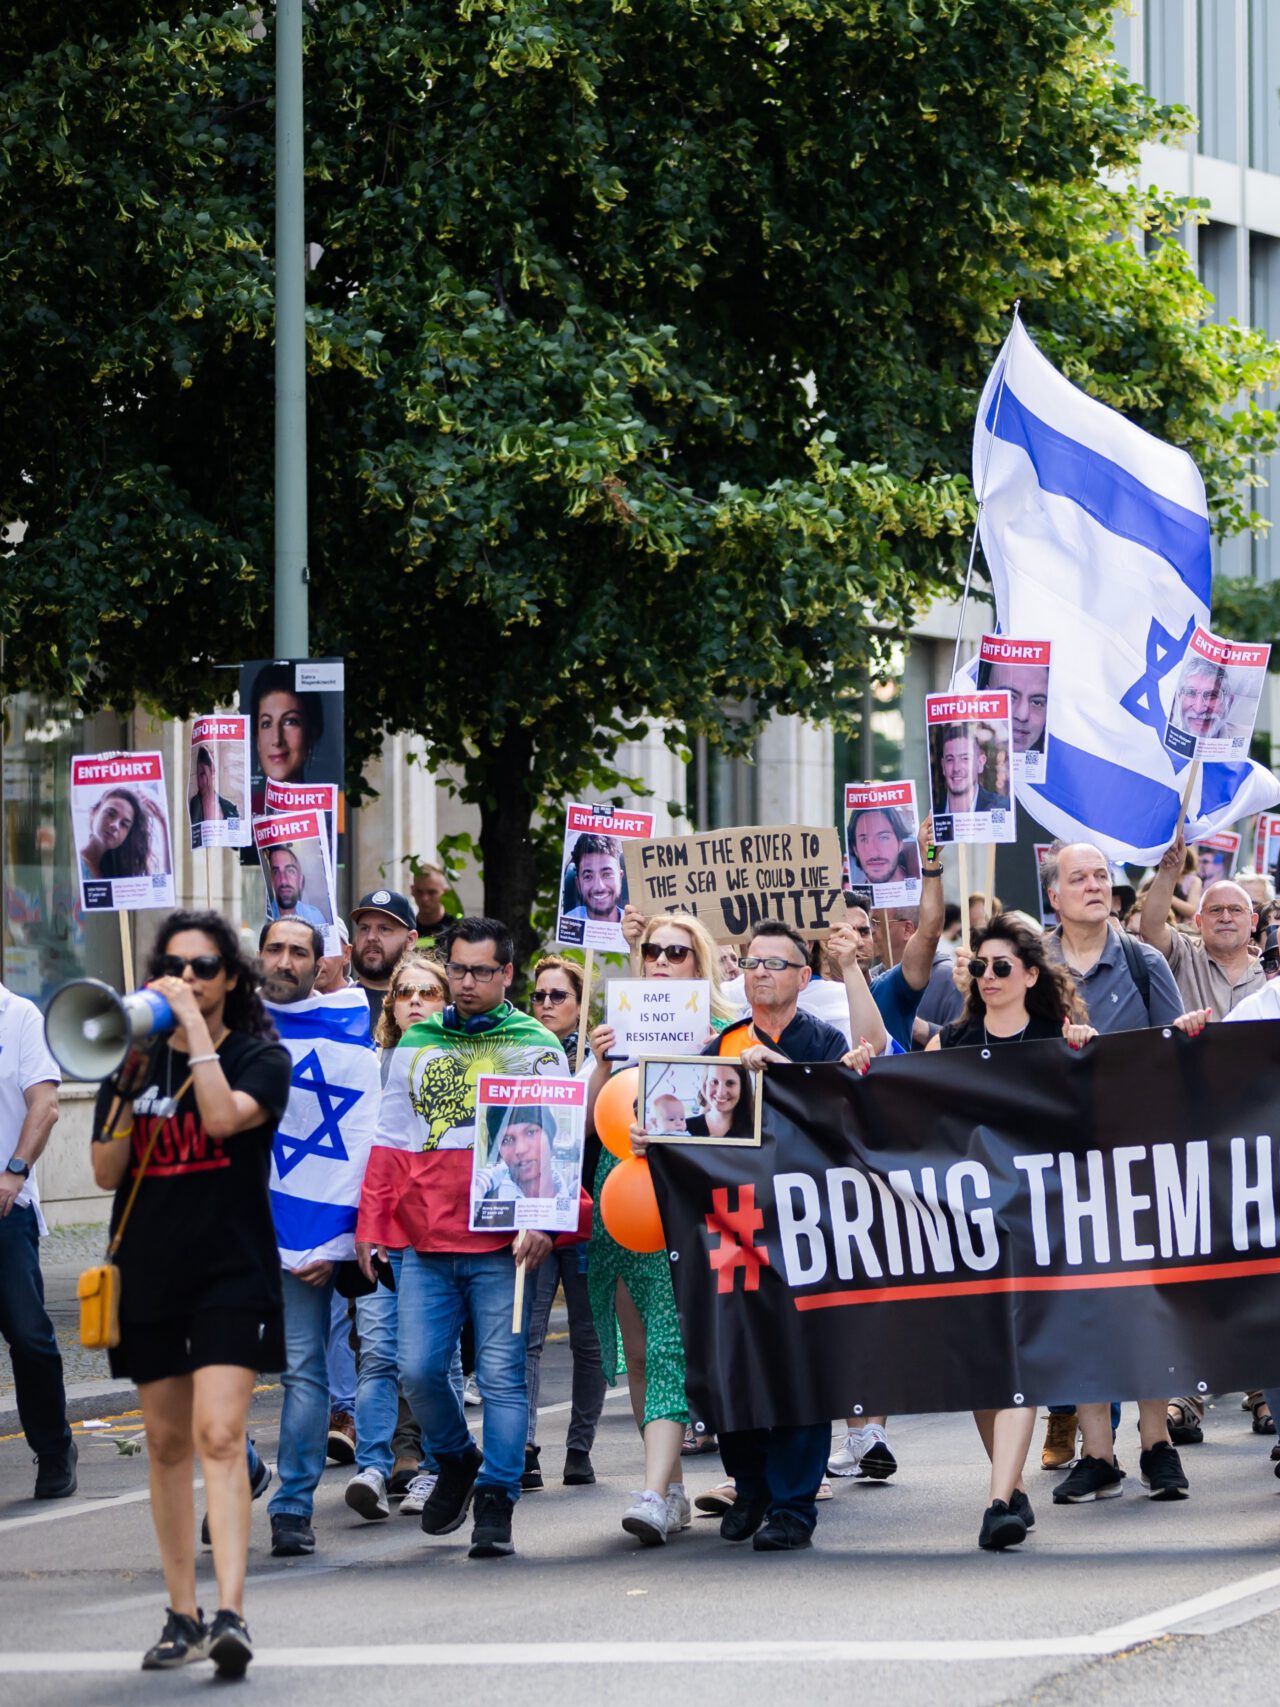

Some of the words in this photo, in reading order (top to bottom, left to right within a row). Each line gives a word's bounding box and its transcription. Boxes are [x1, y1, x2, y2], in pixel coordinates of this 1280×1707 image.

[982, 642, 1043, 659] ENTFÜHRT
[1194, 635, 1262, 662] ENTFÜHRT
[931, 700, 1000, 717] ENTFÜHRT
[192, 723, 238, 740] ENTFÜHRT
[77, 761, 154, 780] ENTFÜHRT
[267, 789, 325, 806] ENTFÜHRT
[848, 789, 905, 804] ENTFÜHRT
[256, 819, 311, 841] ENTFÜHRT
[641, 843, 689, 869] FROM
[696, 837, 734, 866] THE
[740, 832, 793, 864] RIVER
[800, 832, 821, 859] TO
[645, 875, 677, 899] THE
[684, 869, 717, 893] SEA
[726, 867, 750, 890] WE
[755, 867, 796, 890] COULD
[800, 865, 830, 887] LIVE
[720, 888, 842, 936] UNITY
[643, 993, 671, 1003] RAPE
[640, 1012, 650, 1022] IS
[652, 1012, 676, 1022] NOT
[626, 1031, 694, 1042] RESISTANCE!
[488, 1083, 577, 1099] ENTFÜHRT
[704, 1160, 1000, 1294] #BRING
[1013, 1139, 1211, 1267] THEM
